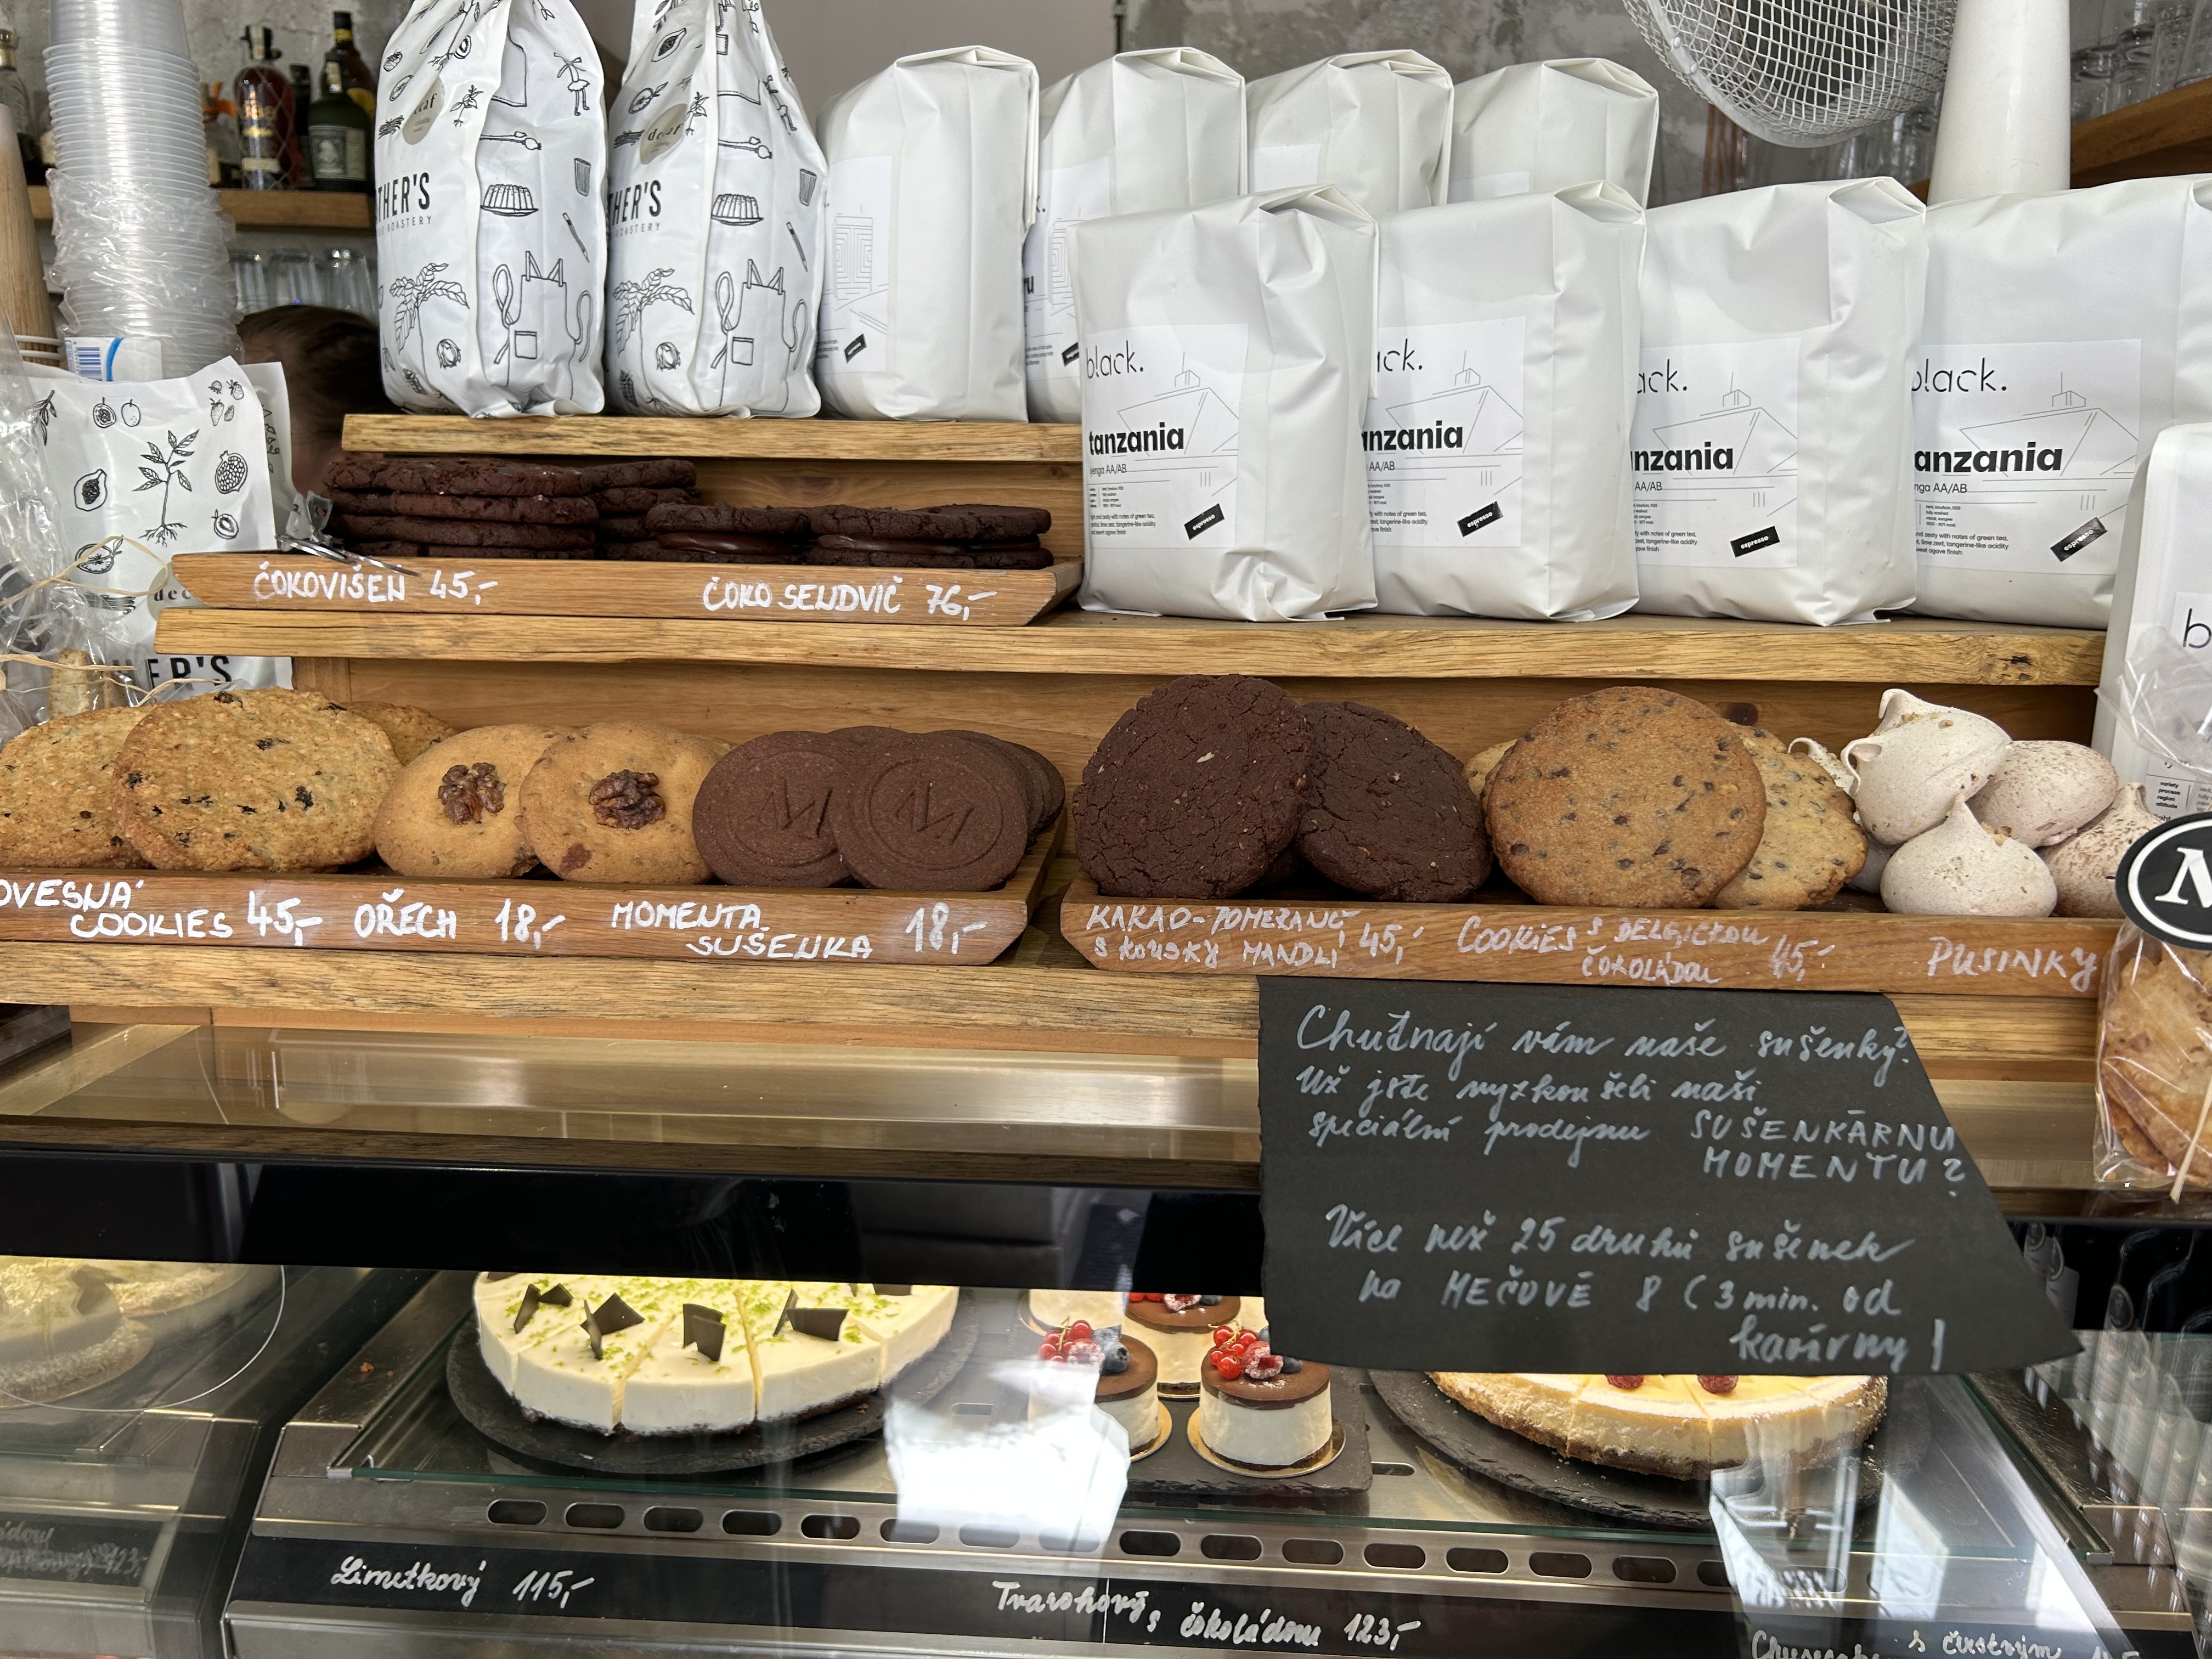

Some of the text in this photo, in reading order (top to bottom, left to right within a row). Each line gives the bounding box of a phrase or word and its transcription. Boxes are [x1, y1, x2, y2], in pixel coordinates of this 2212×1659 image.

[387, 215, 432, 233] ROASTERY
[1086, 340, 1144, 380] black.
[1088, 421, 1184, 455] tanzania
[1630, 441, 1734, 472] nzania
[1914, 441, 2063, 473] anzania
[1106, 464, 1127, 475] AA/AB
[1369, 461, 1395, 472] AA/AB
[1634, 481, 1662, 492] AA/AB
[1933, 483, 1967, 494] AA/AB
[1466, 511, 1493, 529] espresso
[1740, 535, 1769, 549] espresso
[1987, 543, 2009, 551] acidity
[430, 569, 499, 606] 45,-
[703, 575, 998, 621] ČOKO SENDVIČ 76,-
[70, 890, 323, 946] COOKIES 45,-
[354, 888, 566, 950] OŘECH 18,-
[611, 900, 988, 955] MOMENTA 18,-
[686, 926, 873, 961] SUŠENKA
[1358, 922, 1425, 966] 45,-
[1296, 1003, 1498, 1082] Chutnají
[1511, 1020, 1616, 1055] vám
[1624, 1018, 1728, 1058] naše
[1295, 1063, 1351, 1095] Už
[1358, 1069, 1430, 1119] jste
[1308, 1108, 1464, 1148] speciální
[1484, 1114, 1651, 1169] prodejnu
[1324, 1203, 1403, 1254] Více
[1423, 1209, 1497, 1254] než
[1510, 1215, 1567, 1255] 25
[1357, 1268, 1402, 1303] na
[1635, 1274, 1662, 1312] 8
[1743, 1286, 1819, 1311] min.
[1842, 1278, 1903, 1316] od
[330, 1556, 595, 1609] Limetkový 115,-
[992, 1580, 1150, 1624] Tvarohový
[1180, 1601, 1323, 1647] čokoládou
[1344, 1612, 1422, 1651] 123,-
